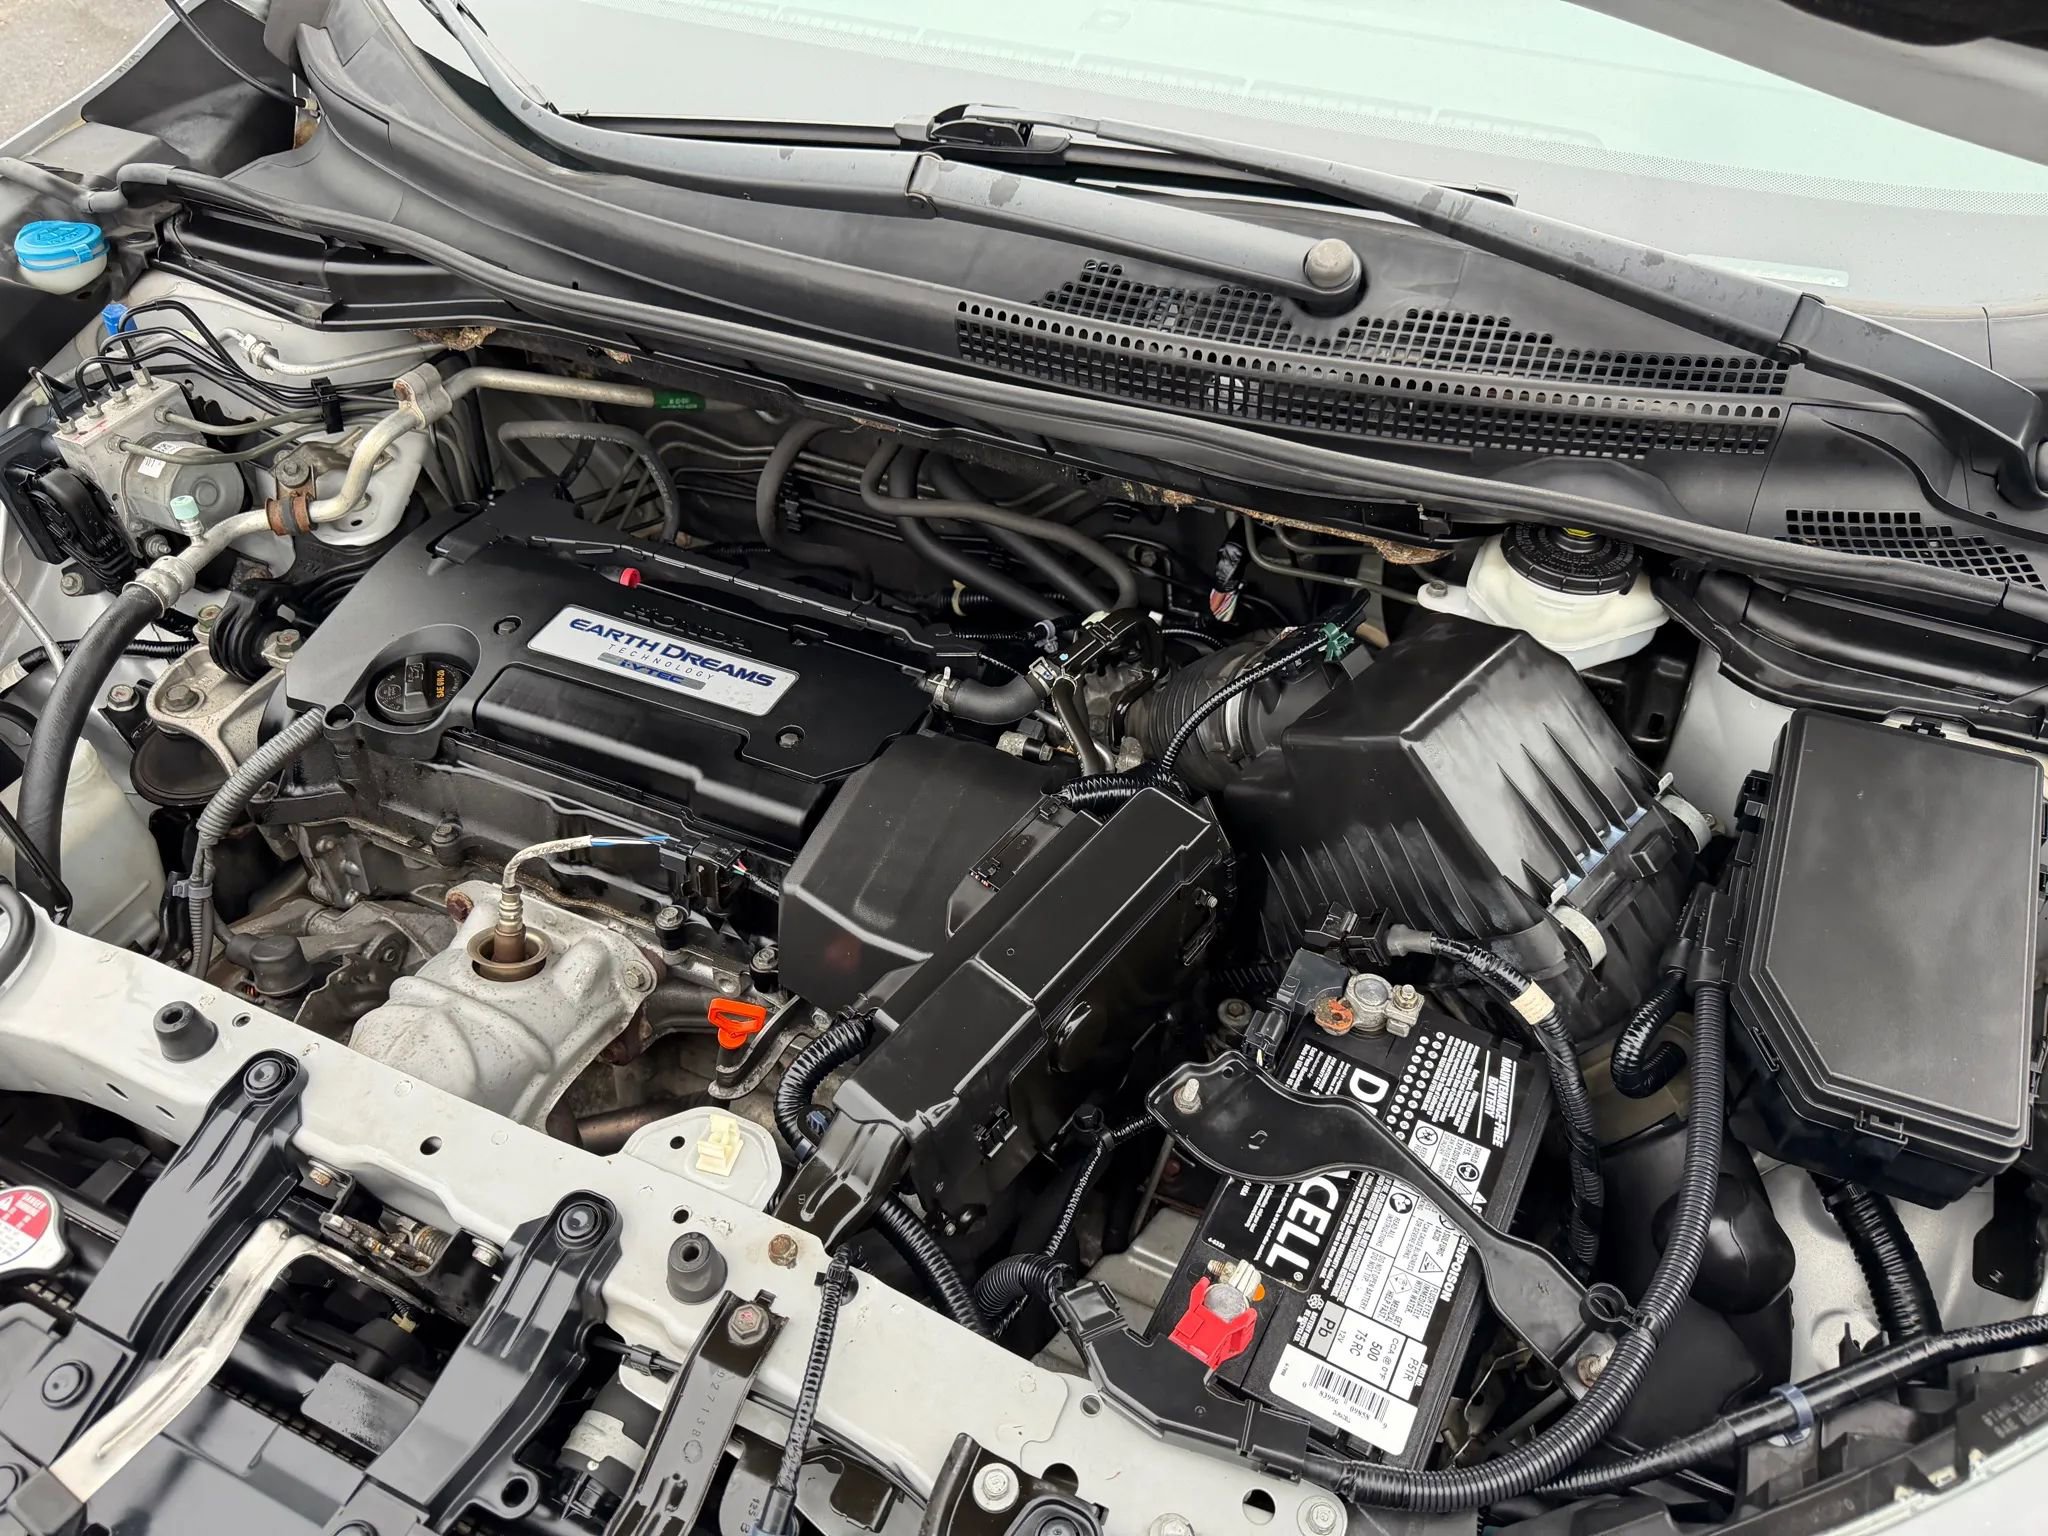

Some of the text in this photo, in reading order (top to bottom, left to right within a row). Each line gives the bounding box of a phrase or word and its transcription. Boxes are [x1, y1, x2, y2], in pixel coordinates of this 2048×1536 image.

[569, 617, 776, 687] EARTH DREAMS
[608, 643, 714, 680] TECHNOLOGY
[436, 686, 444, 697] SAE
[1483, 1075, 1498, 1118] BATTERY
[1492, 1056, 1512, 1148] MAINTENANCE-FREE
[1444, 1138, 1463, 1180] EXPLOSIVE GASES
[1469, 1145, 1481, 1164] SHIELD
[1375, 1212, 1393, 1248] INSTRUCTIONS
[1386, 1215, 1400, 1239] READ ALL
[1431, 1228, 1441, 1241] ACID
[1435, 1231, 1450, 1257] SULFURIC
[1365, 1259, 1376, 1272] NOT
[1370, 1251, 1379, 1260] DO
[1377, 1254, 1386, 1263] DO
[1372, 1261, 1383, 1275] NOT
[1367, 1273, 1379, 1289] OPEN
[1411, 1279, 1422, 1294] WITH
[1383, 1289, 1393, 1304] HELP
[1411, 1282, 1429, 1320] IMMEDIATELY
[1421, 1286, 1437, 1319] FLUSH EYES
[1384, 1298, 1399, 1324] MEDICAL
[1392, 1315, 1402, 1327] GET
[1317, 1316, 1335, 1339] Pb
[1336, 1329, 1346, 1343] 12V
[1348, 1328, 1367, 1357] 75 RC
[1366, 1340, 1382, 1362] 500
[1387, 1337, 1399, 1355] CCA
[1402, 1357, 1419, 1382] P51R
